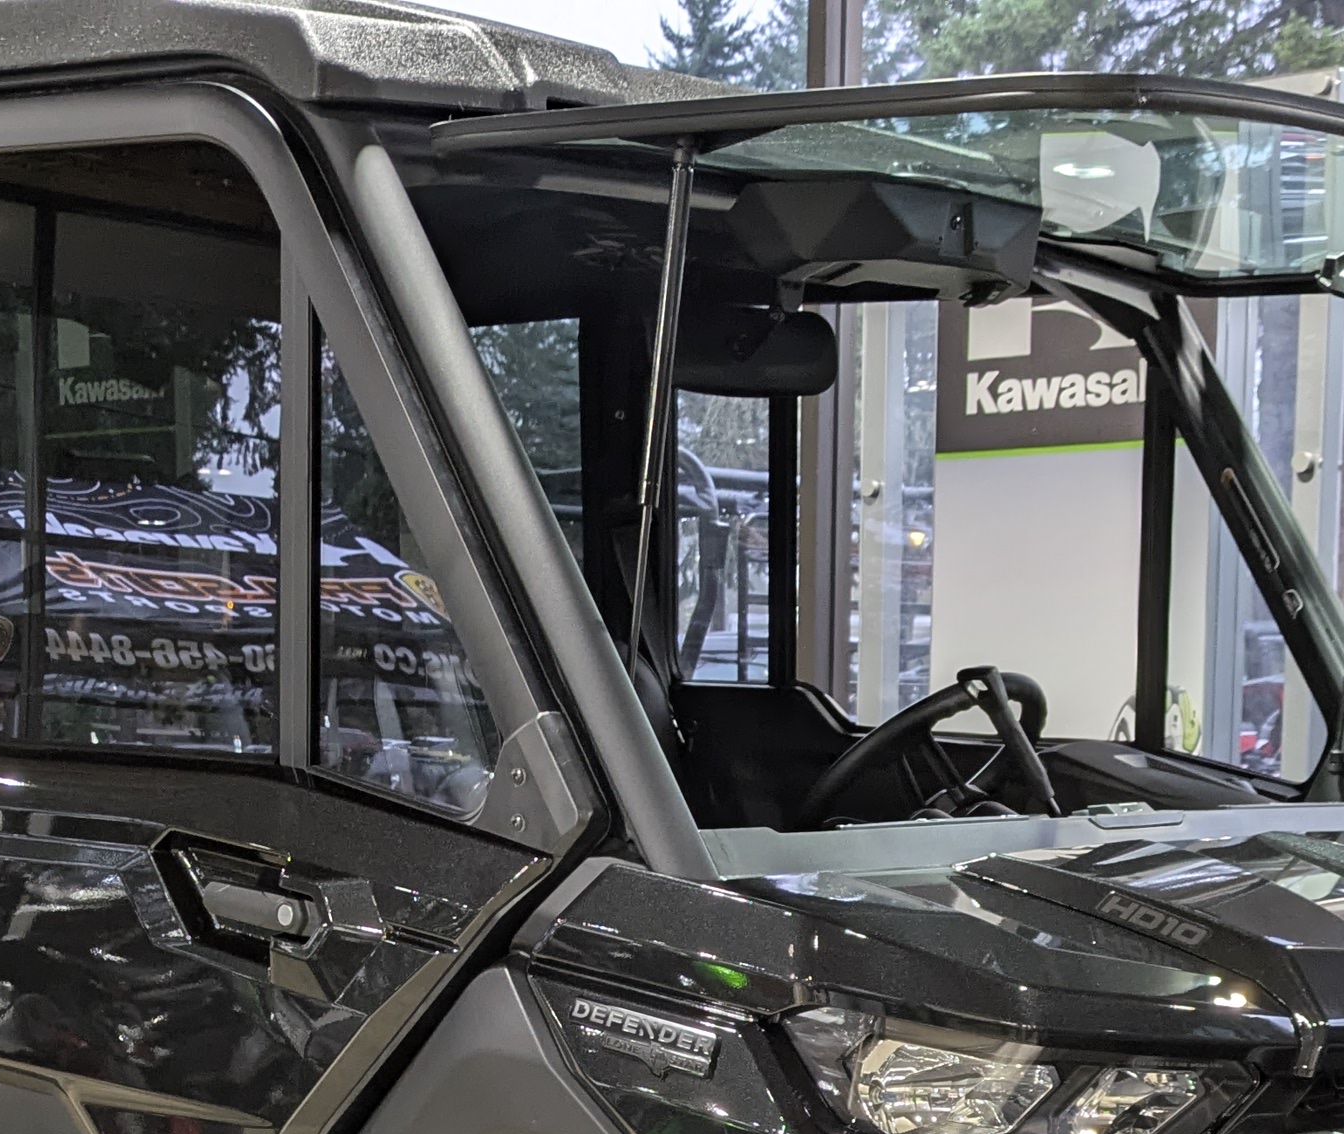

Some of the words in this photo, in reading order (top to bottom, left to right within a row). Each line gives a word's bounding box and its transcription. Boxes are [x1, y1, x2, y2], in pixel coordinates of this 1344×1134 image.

[1101, 895, 1208, 946] HD10
[571, 998, 714, 1056] DEFENDER
[606, 1036, 641, 1055] LONE
[669, 1055, 705, 1073] STAR
